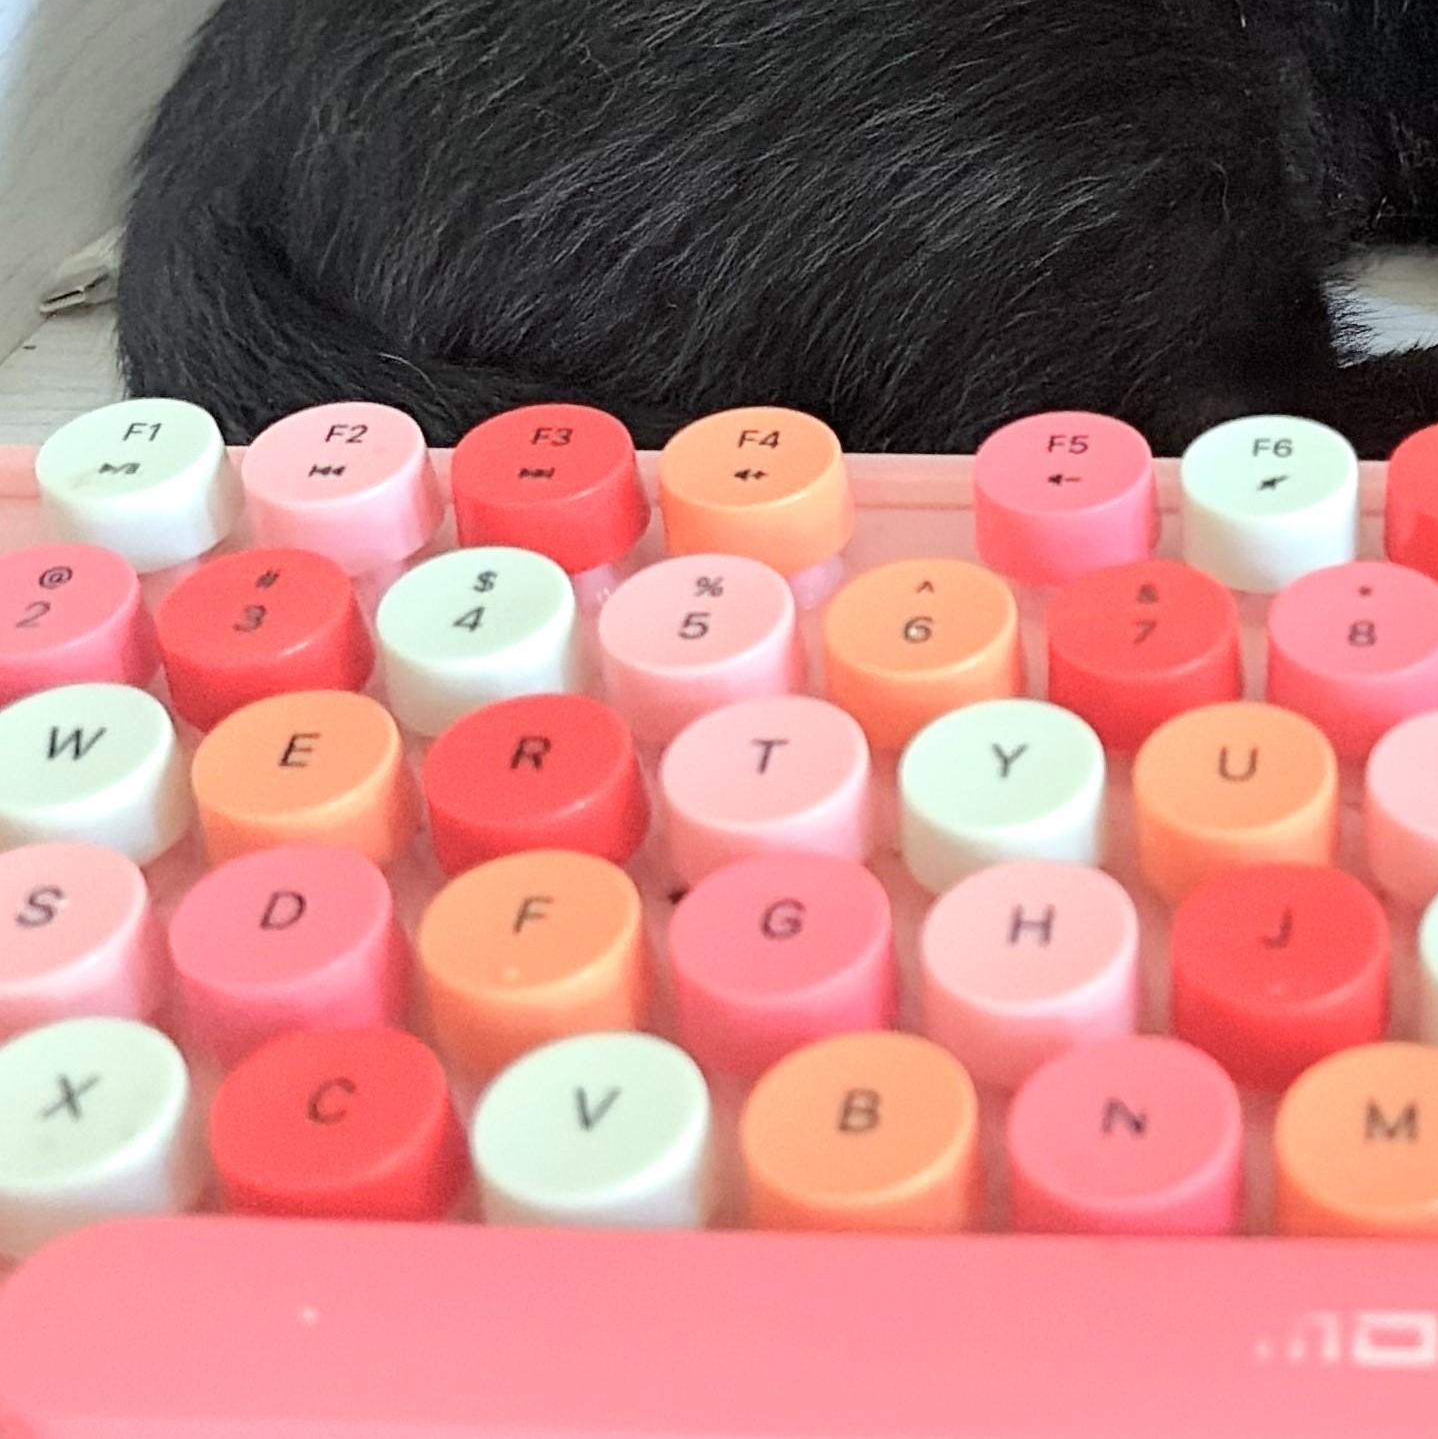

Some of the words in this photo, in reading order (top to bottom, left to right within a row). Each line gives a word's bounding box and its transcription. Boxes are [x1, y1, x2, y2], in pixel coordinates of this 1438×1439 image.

[123, 423, 162, 441] F1
[325, 424, 368, 443] F2
[531, 427, 573, 446] F3
[738, 430, 779, 448] F4
[1048, 435, 1088, 454] F5
[1252, 438, 1293, 458] F6
[39, 566, 73, 589] @
[473, 571, 497, 593] $
[696, 576, 723, 597] %
[16, 601, 51, 628] 2
[233, 605, 267, 632] 3
[453, 606, 485, 632] 4
[678, 612, 710, 640] 5
[903, 616, 933, 643] 6
[1133, 620, 1157, 645] 7
[1348, 621, 1377, 647] 8
[48, 727, 105, 760] W
[279, 734, 319, 767] E
[510, 736, 551, 770] R
[754, 740, 788, 774] T
[992, 744, 1028, 778] Y
[1218, 746, 1258, 782] U
[16, 886, 64, 928] S
[260, 892, 306, 930] D
[513, 896, 553, 934] F
[760, 898, 805, 940] G
[1008, 905, 1055, 946] H
[1262, 908, 1293, 949] J
[42, 1076, 98, 1120] X
[306, 1077, 356, 1125] C
[573, 1087, 621, 1131] V
[837, 1089, 880, 1134] B
[1102, 1098, 1147, 1137] N
[1365, 1101, 1419, 1141] M
